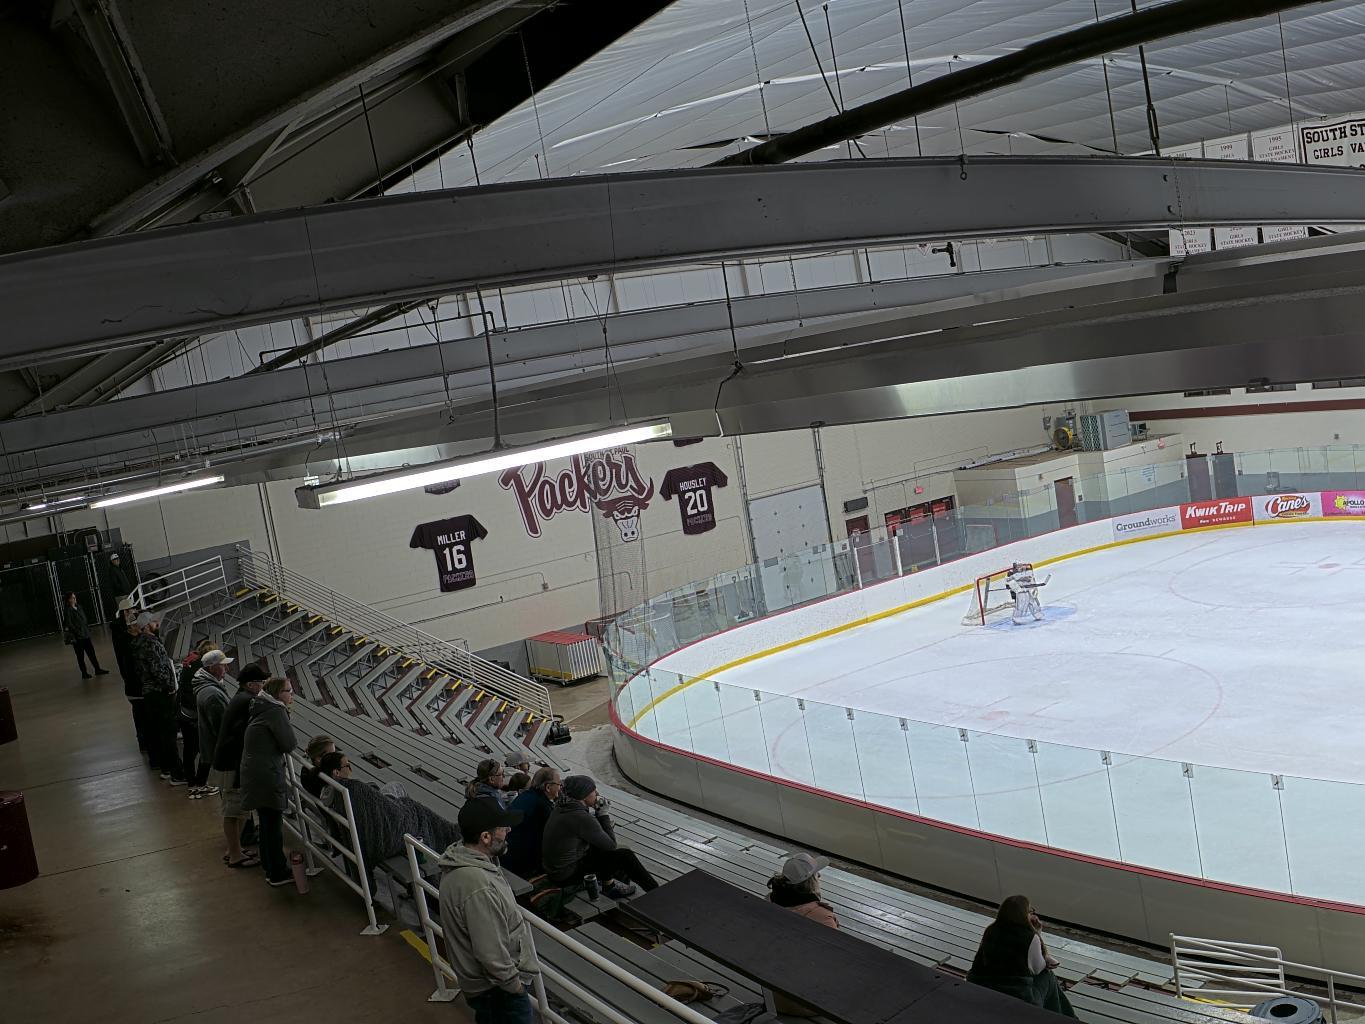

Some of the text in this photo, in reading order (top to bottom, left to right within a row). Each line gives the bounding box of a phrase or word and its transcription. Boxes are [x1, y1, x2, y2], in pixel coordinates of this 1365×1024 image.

[1305, 125, 1347, 144] SOUTH
[1313, 146, 1344, 160] GIRLS
[680, 477, 707, 491] HOUSLEY
[499, 453, 650, 538] Packers
[684, 489, 708, 516] 20
[1185, 501, 1246, 519] KWIK TRIP
[1116, 514, 1177, 531] Groundworks
[437, 530, 467, 545] MILLER
[443, 545, 467, 572] 16
